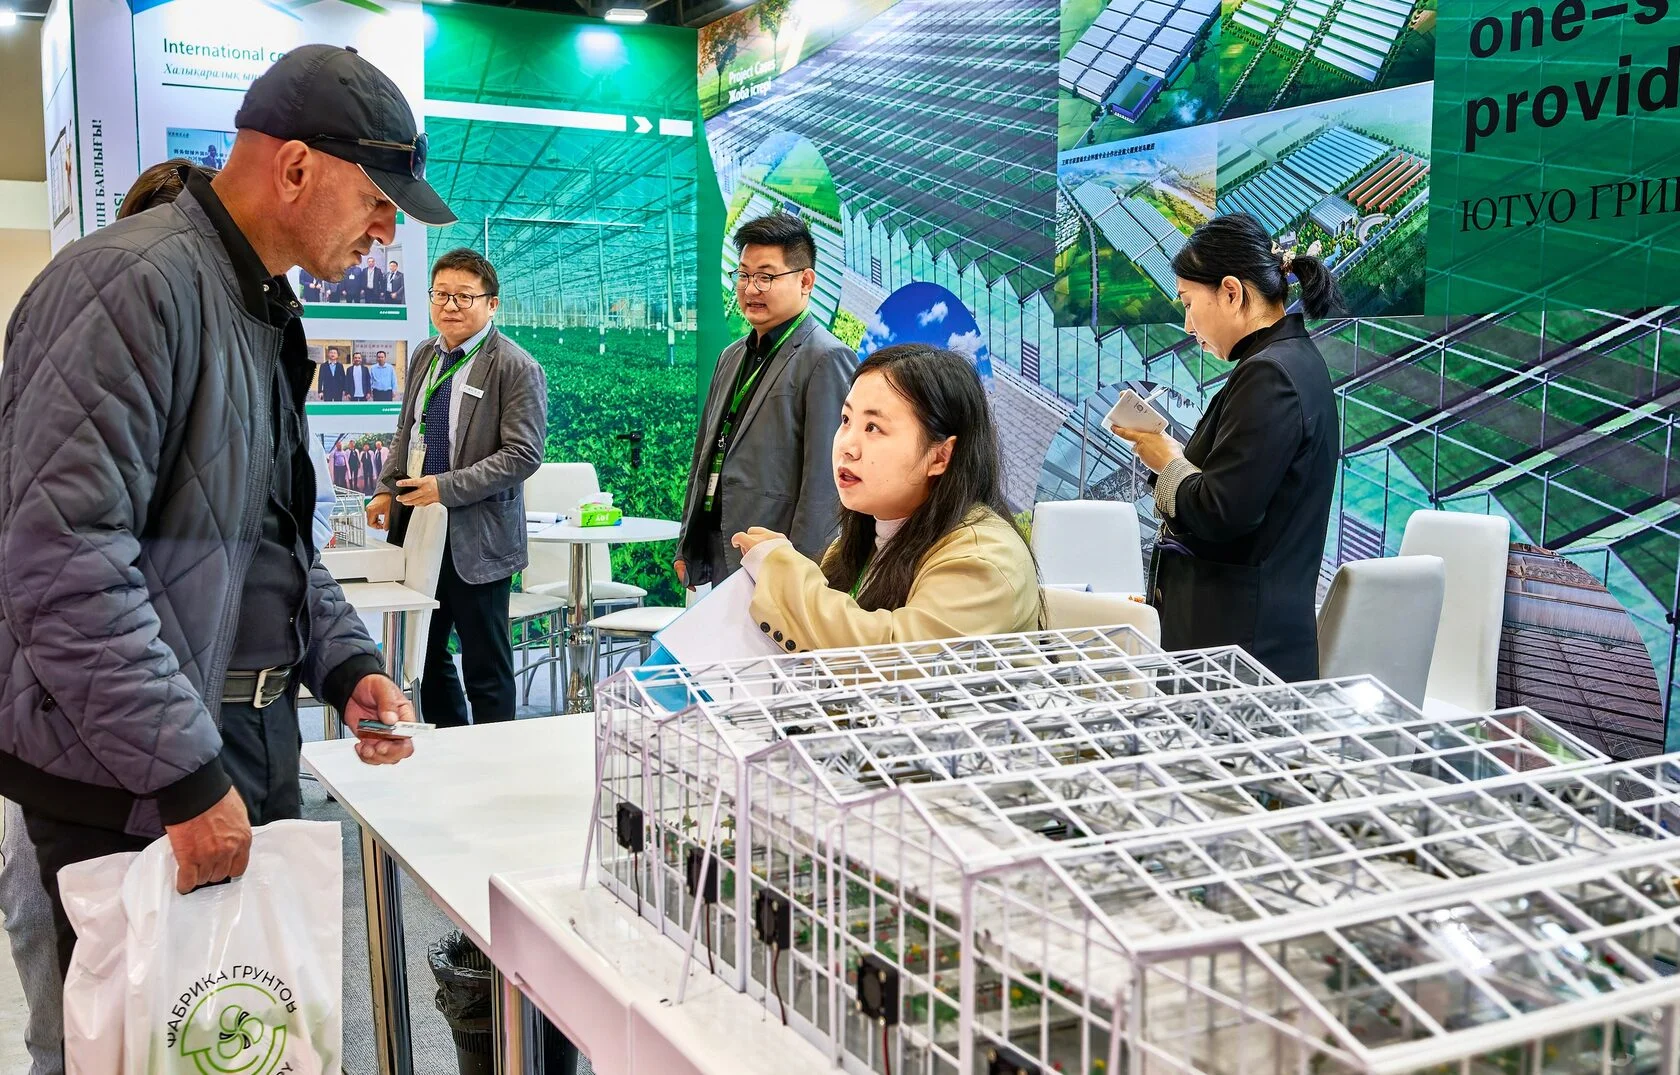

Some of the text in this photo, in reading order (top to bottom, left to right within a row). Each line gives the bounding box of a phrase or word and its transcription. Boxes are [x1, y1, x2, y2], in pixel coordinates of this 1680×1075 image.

[163, 38, 264, 61] International
[729, 67, 753, 84] Project
[728, 85, 750, 104] Жоба
[1465, 45, 1680, 153] provid
[92, 119, 105, 198] БАРЛЫҒЫ!
[1460, 188, 1576, 233] ЮТУО
